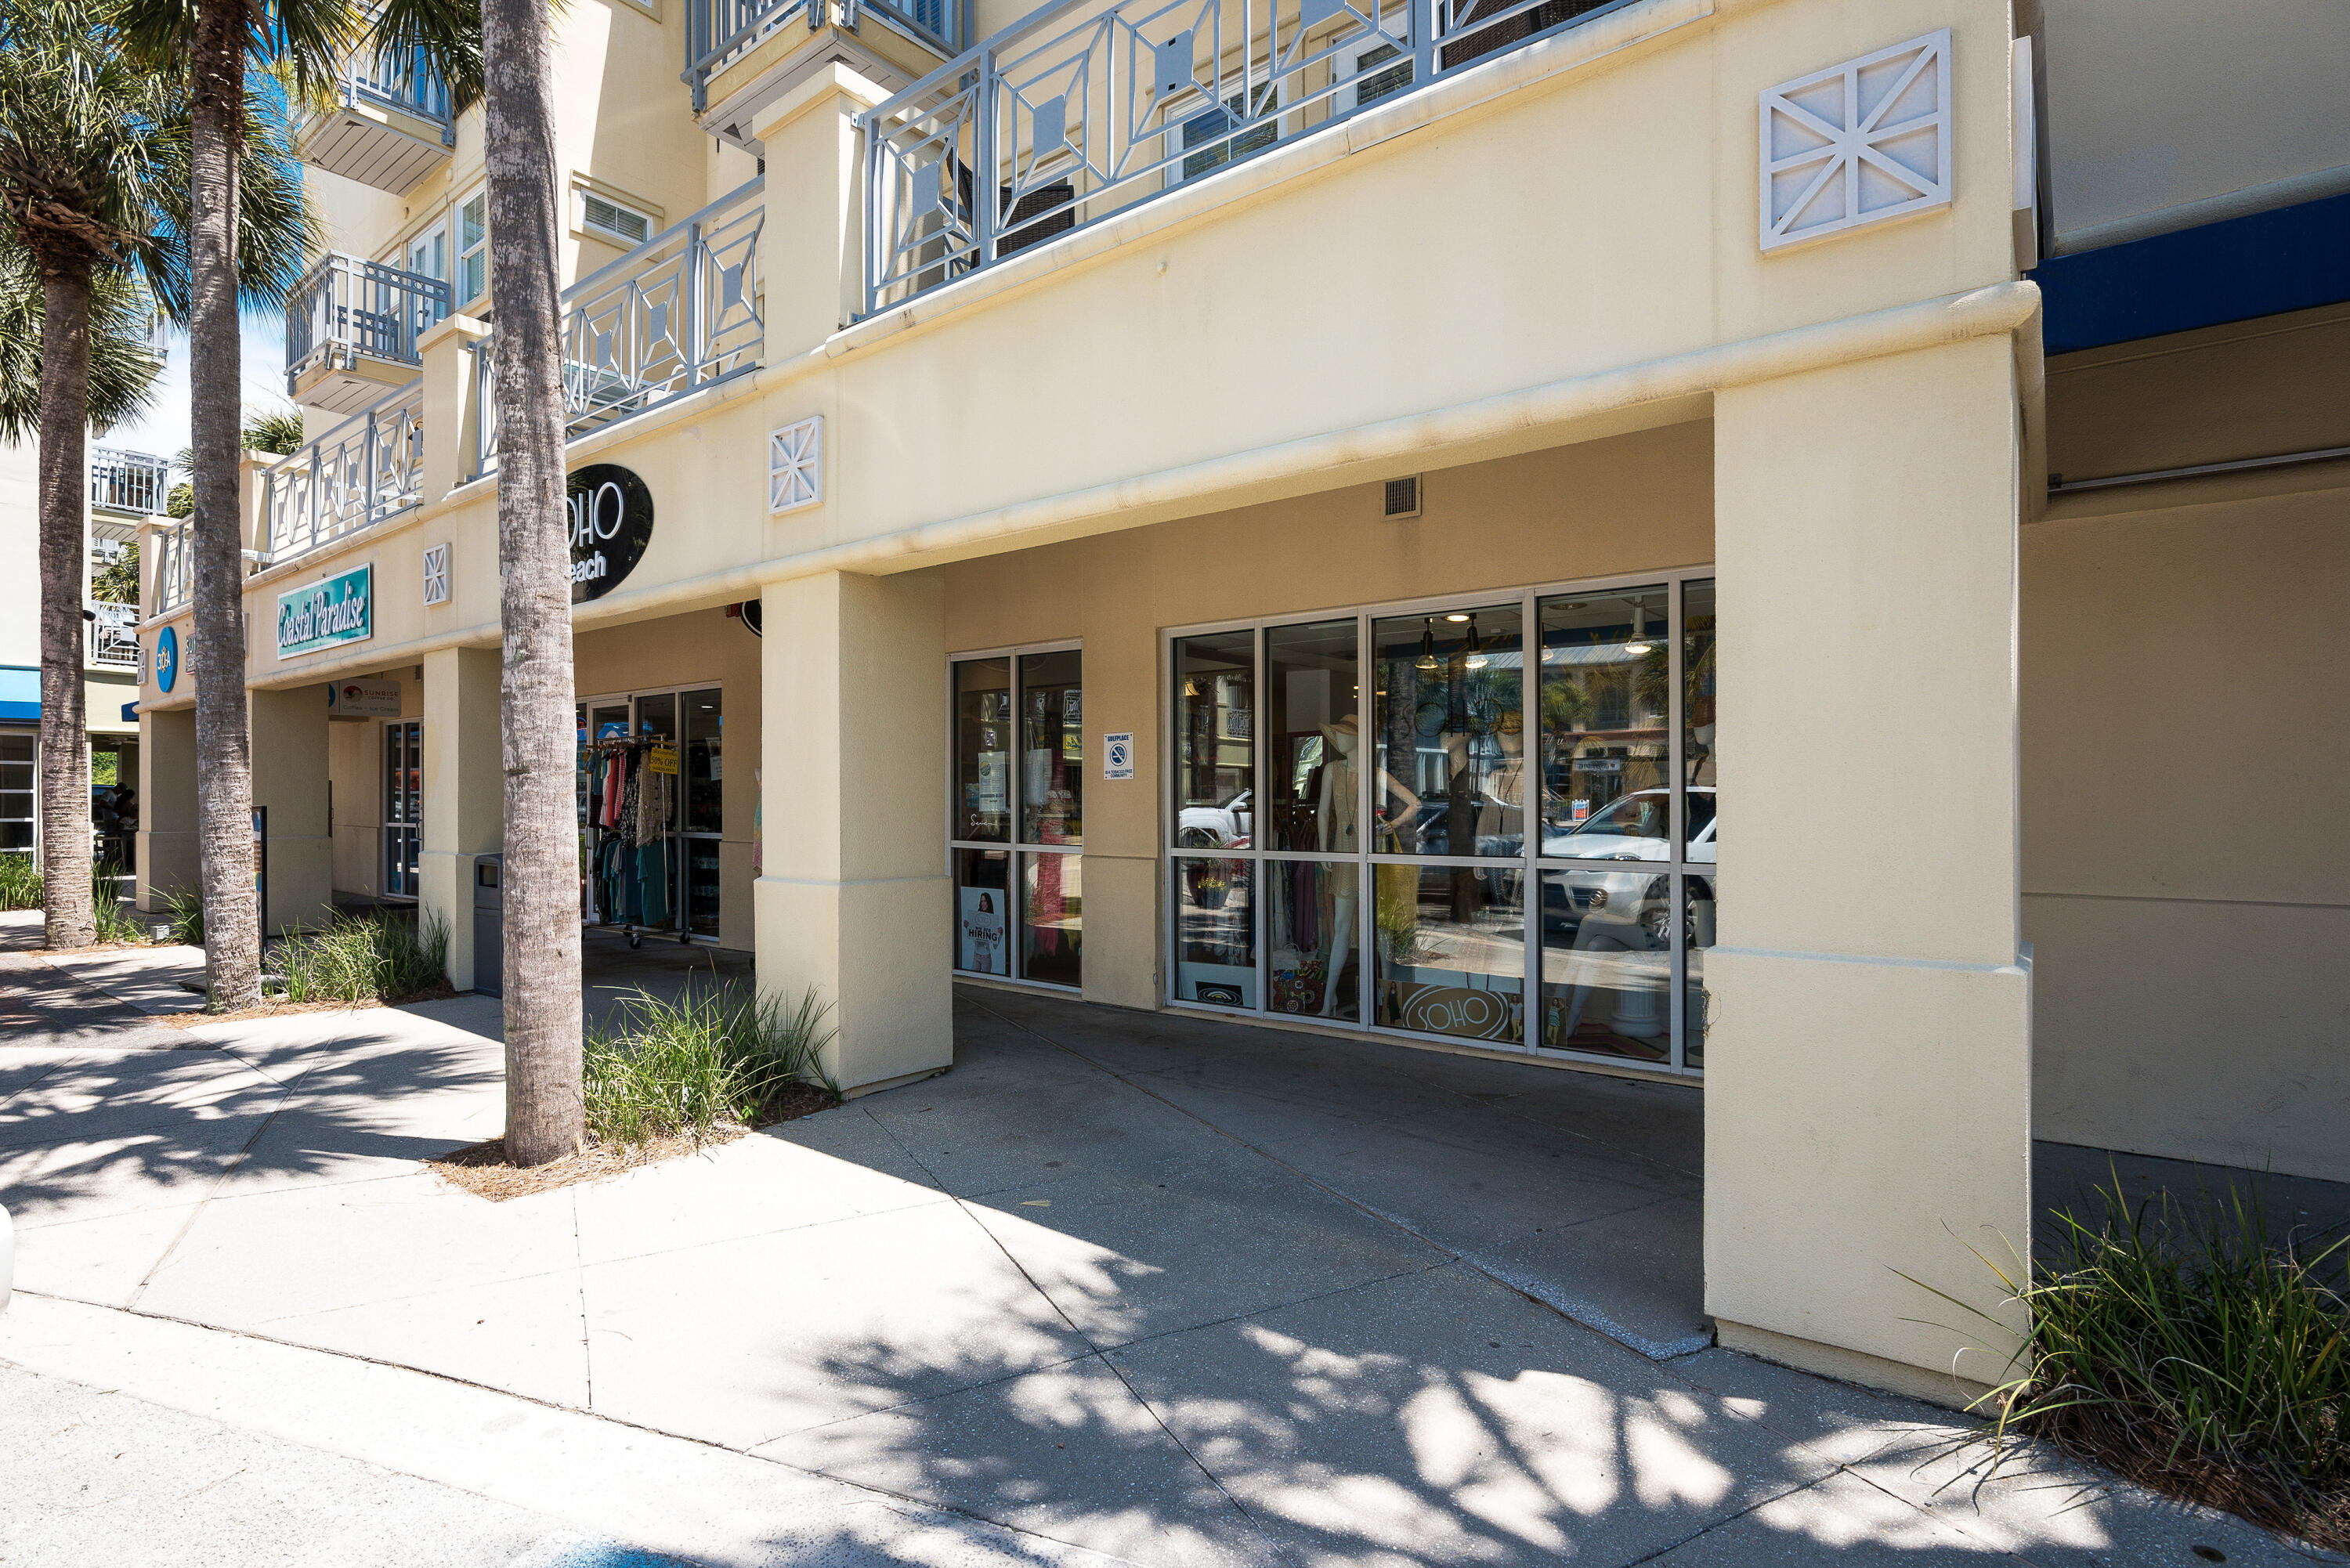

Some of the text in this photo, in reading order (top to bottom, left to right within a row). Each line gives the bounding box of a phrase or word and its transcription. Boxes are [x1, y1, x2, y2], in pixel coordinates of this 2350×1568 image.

[571, 551, 606, 584] each
[278, 580, 364, 647] Coastal Paradise
[651, 756, 678, 768] 50% OFF
[969, 929, 997, 941] HIRING
[1418, 997, 1488, 1031] SOHO
